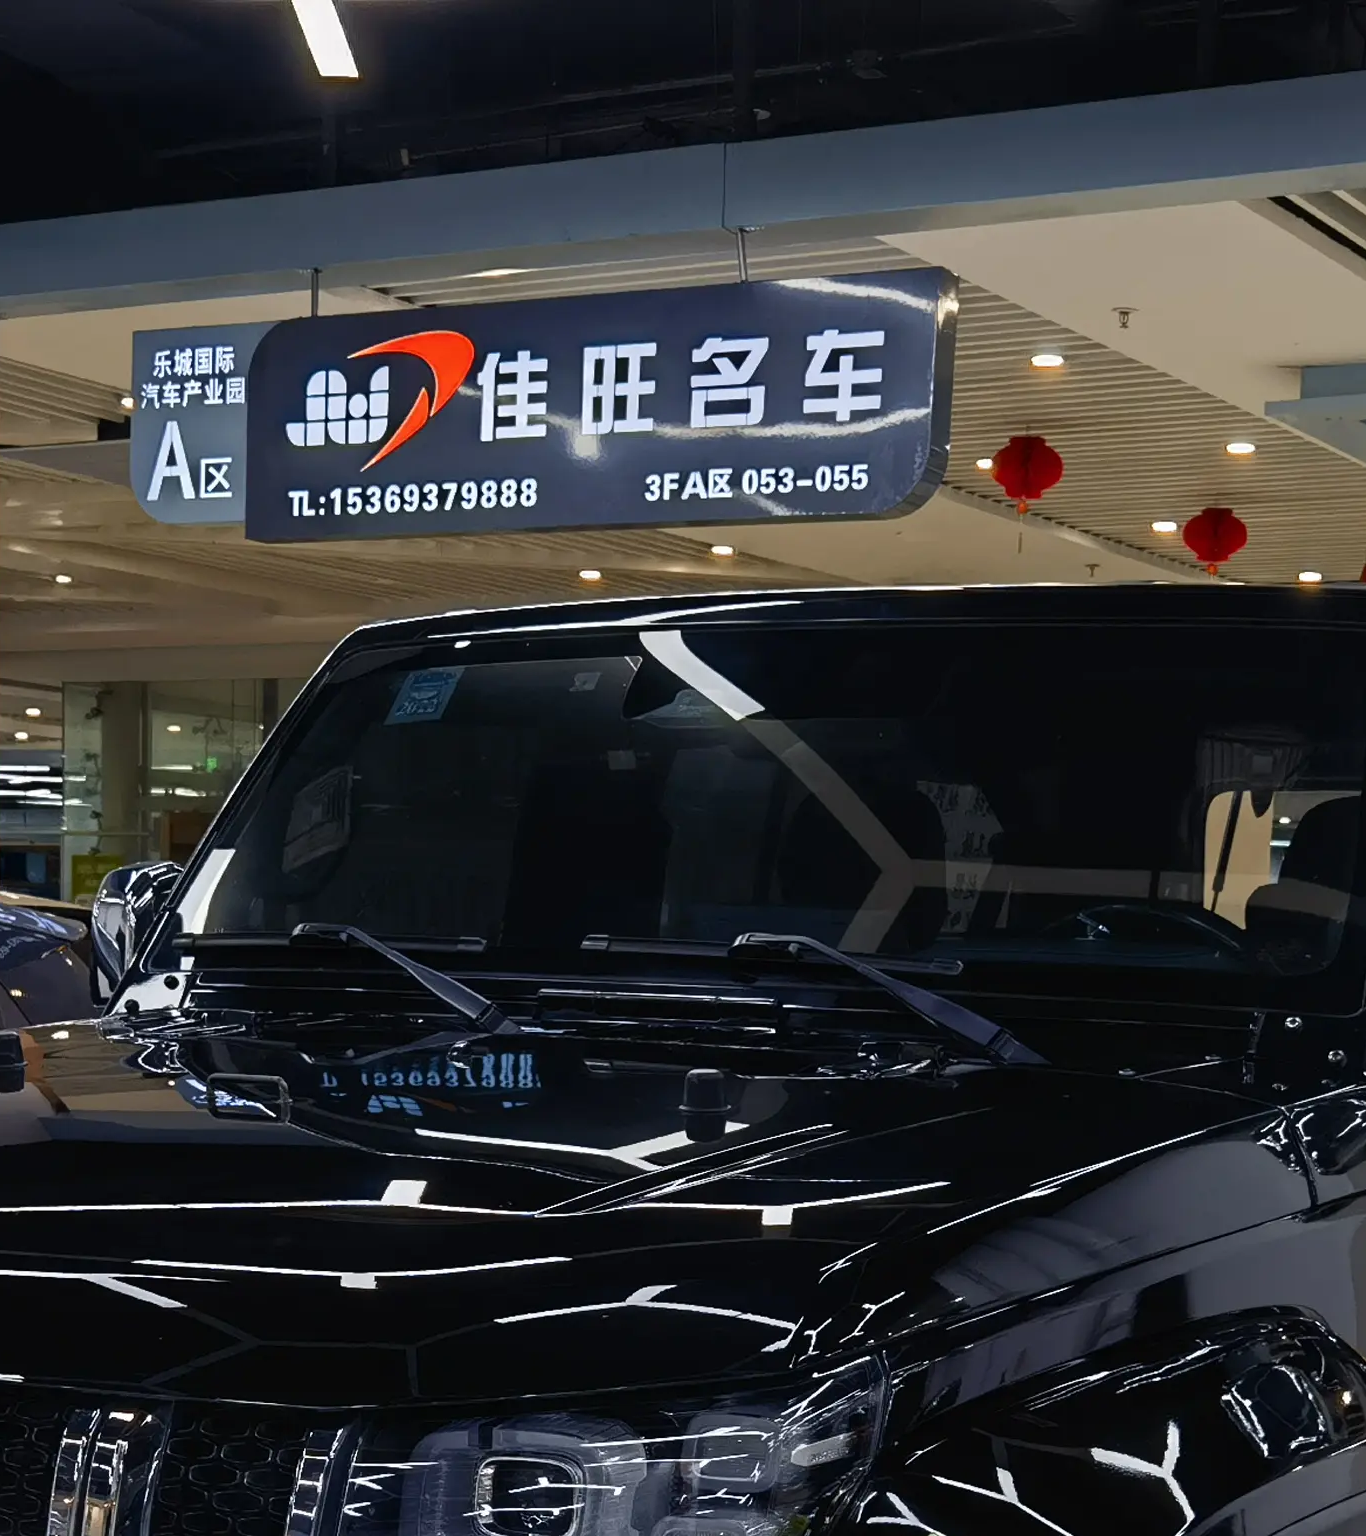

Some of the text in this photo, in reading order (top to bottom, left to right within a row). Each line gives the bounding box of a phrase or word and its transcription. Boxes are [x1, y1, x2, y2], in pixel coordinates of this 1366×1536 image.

[153, 346, 235, 378] 乐城国际
[141, 377, 246, 409] 汽车产业园
[477, 329, 885, 442] 佳旺名车
[147, 421, 233, 501] A区
[645, 464, 869, 501] 3FA区 053-055
